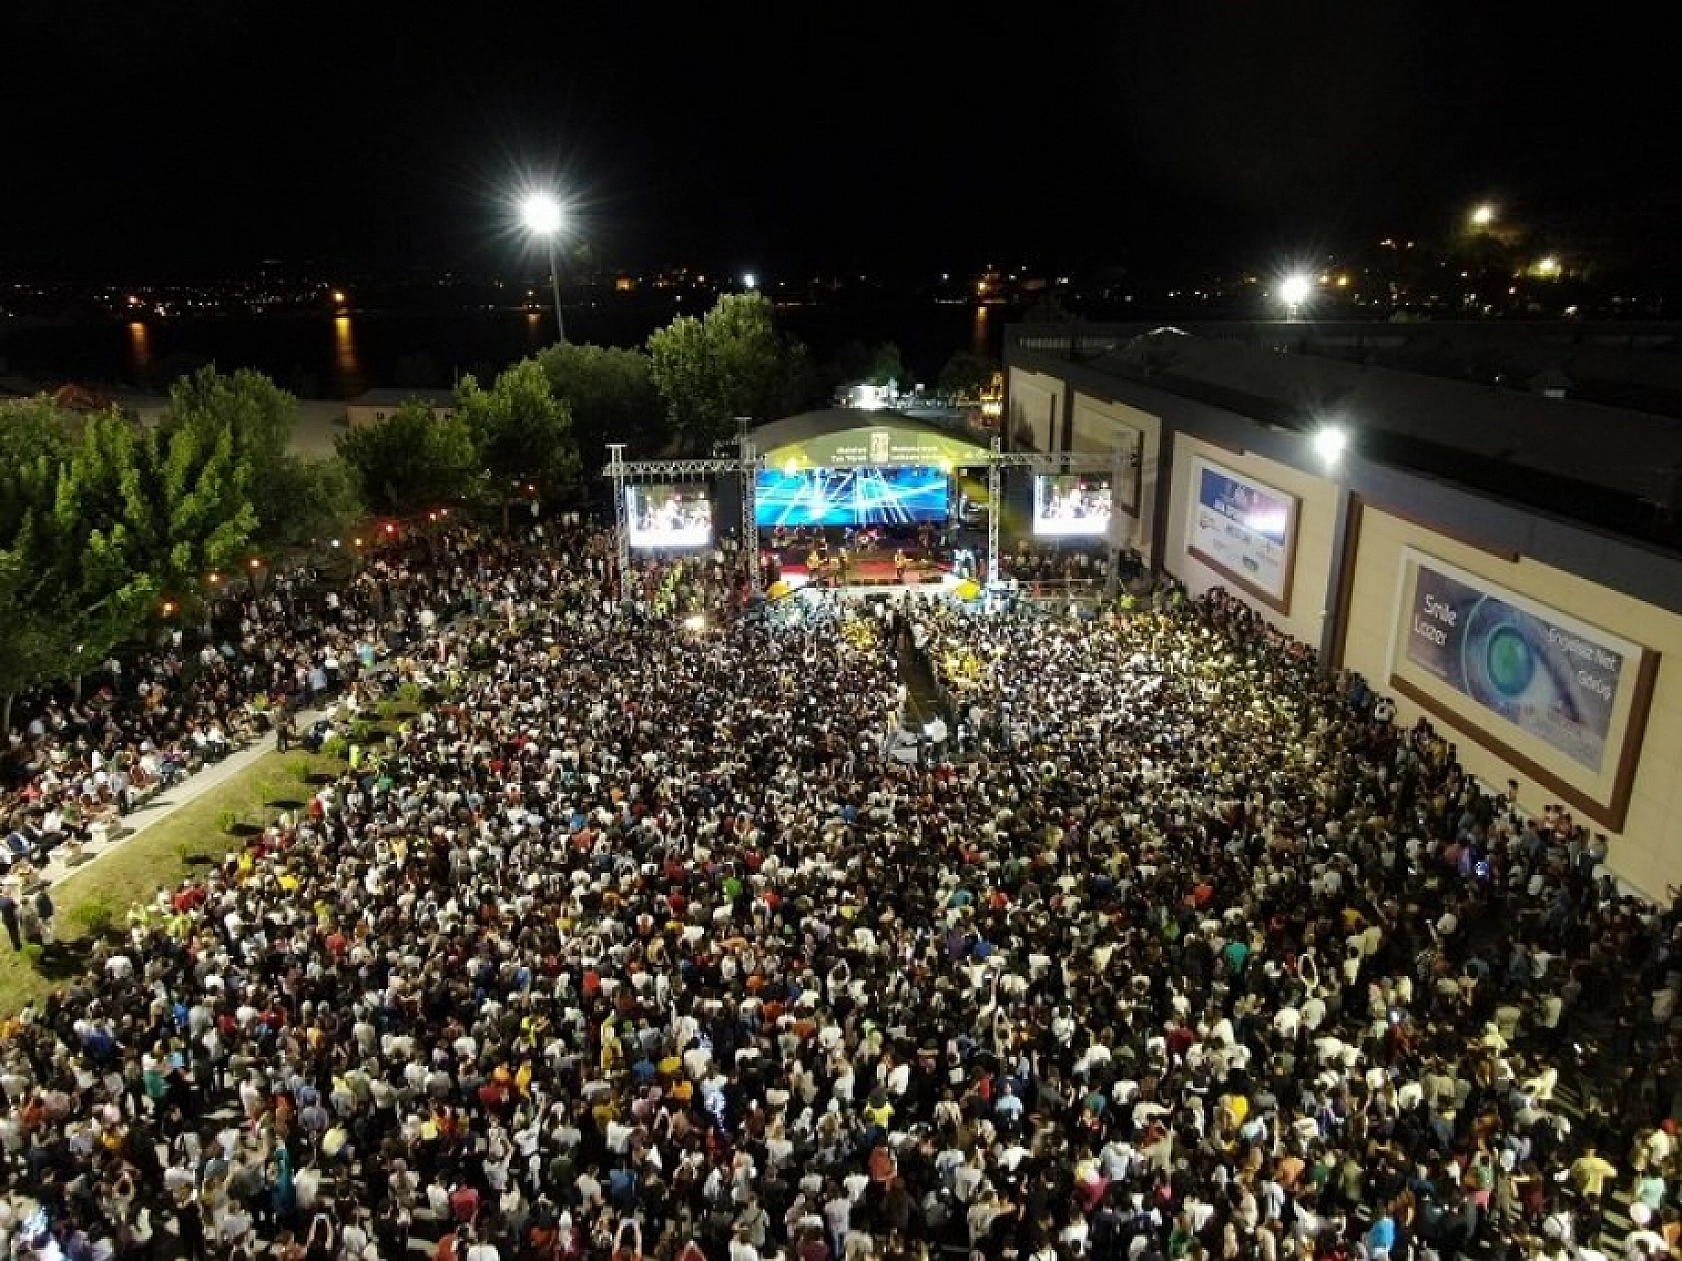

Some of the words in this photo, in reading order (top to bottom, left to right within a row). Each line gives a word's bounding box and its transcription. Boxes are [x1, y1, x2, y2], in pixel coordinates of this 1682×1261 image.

[1424, 594, 1457, 627] Smile
[1414, 613, 1448, 646] Lazer
[1597, 649, 1618, 672] Net
